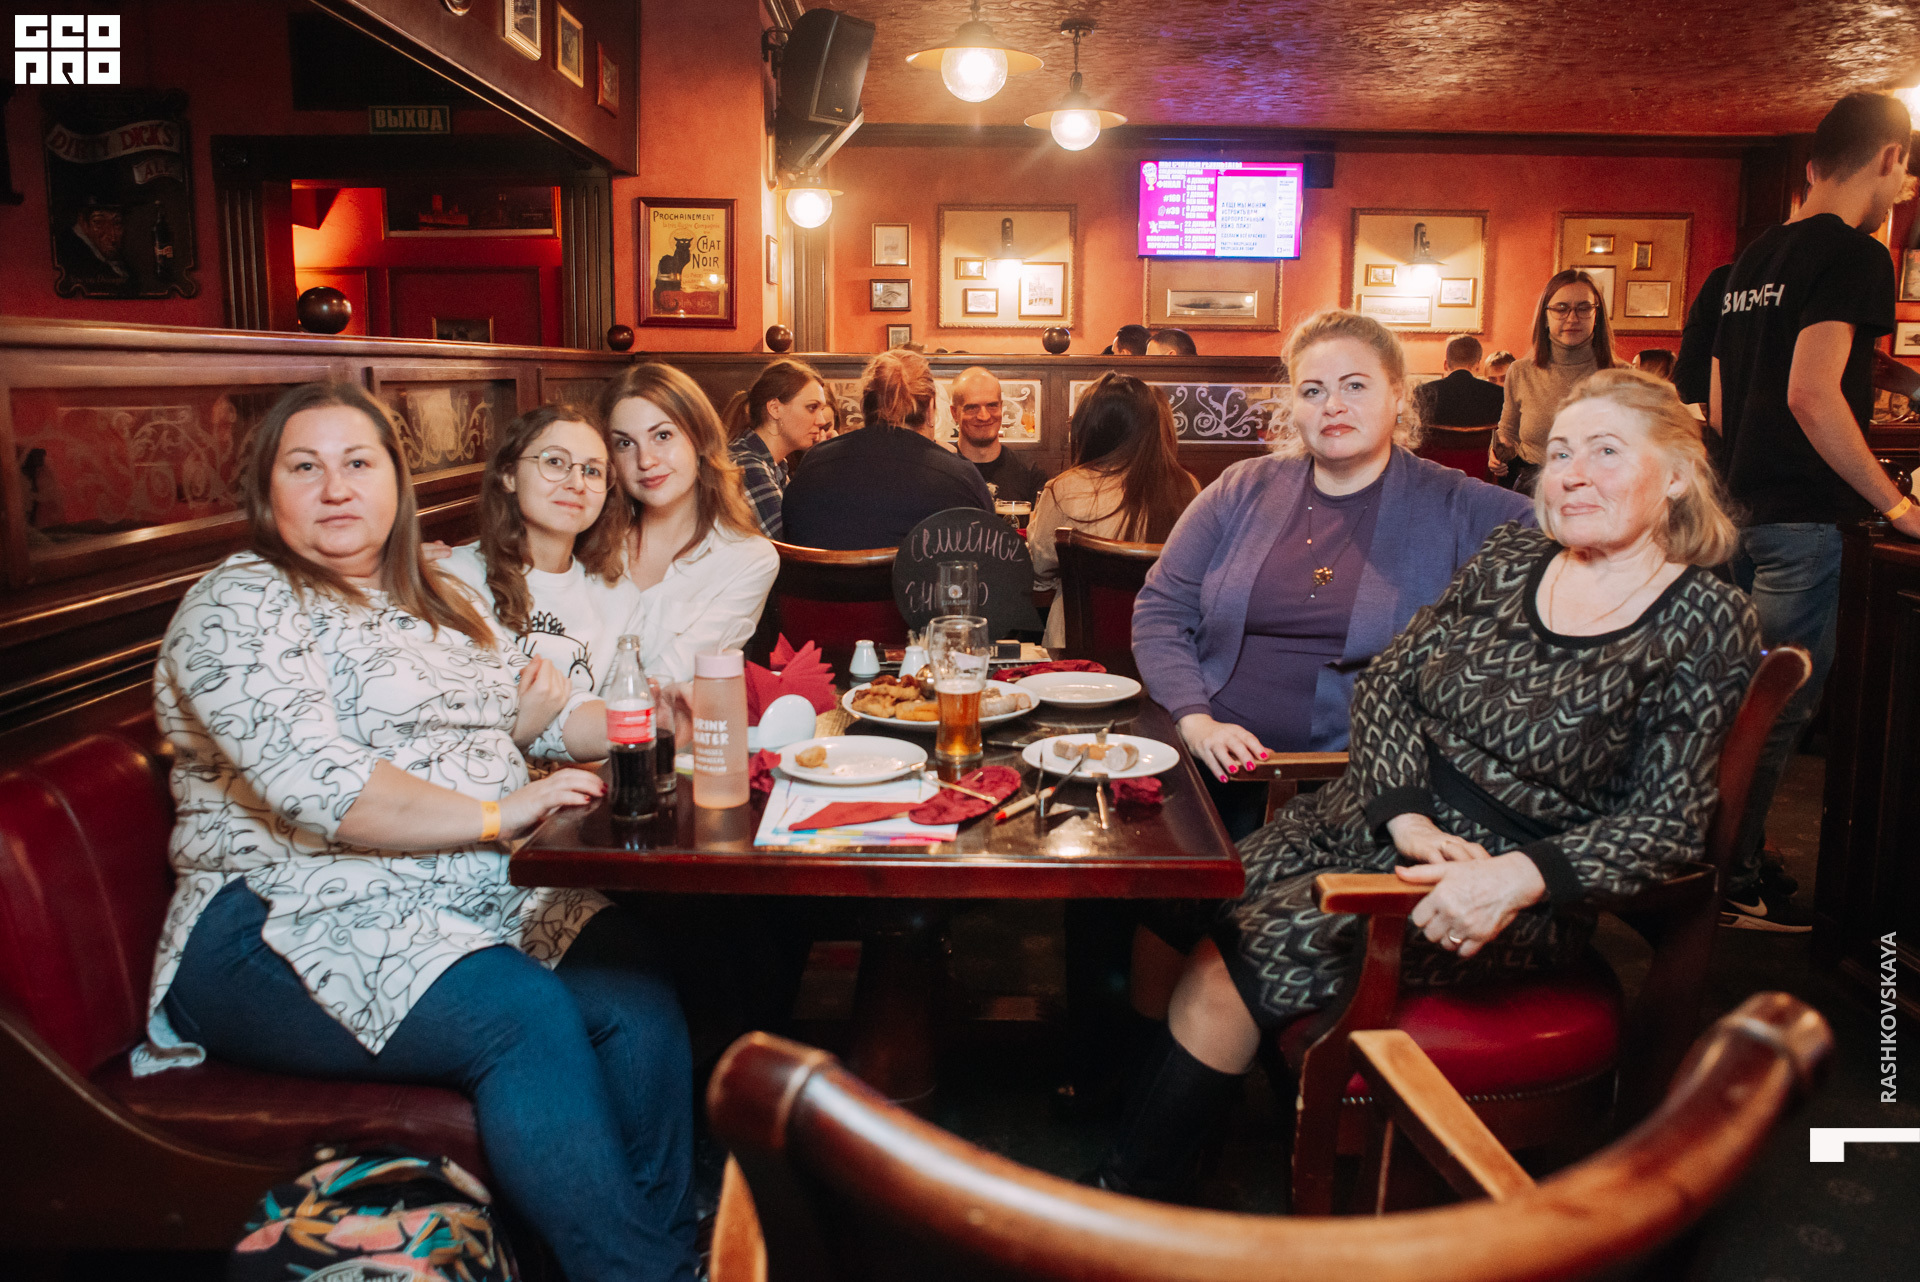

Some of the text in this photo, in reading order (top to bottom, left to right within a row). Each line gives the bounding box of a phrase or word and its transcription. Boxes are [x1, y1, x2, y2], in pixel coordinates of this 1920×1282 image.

[375, 110, 443, 131] ВЫХОД
[653, 210, 715, 222] PROCHAINEMENT
[696, 235, 721, 253] CHAT
[692, 254, 719, 269] NOIR
